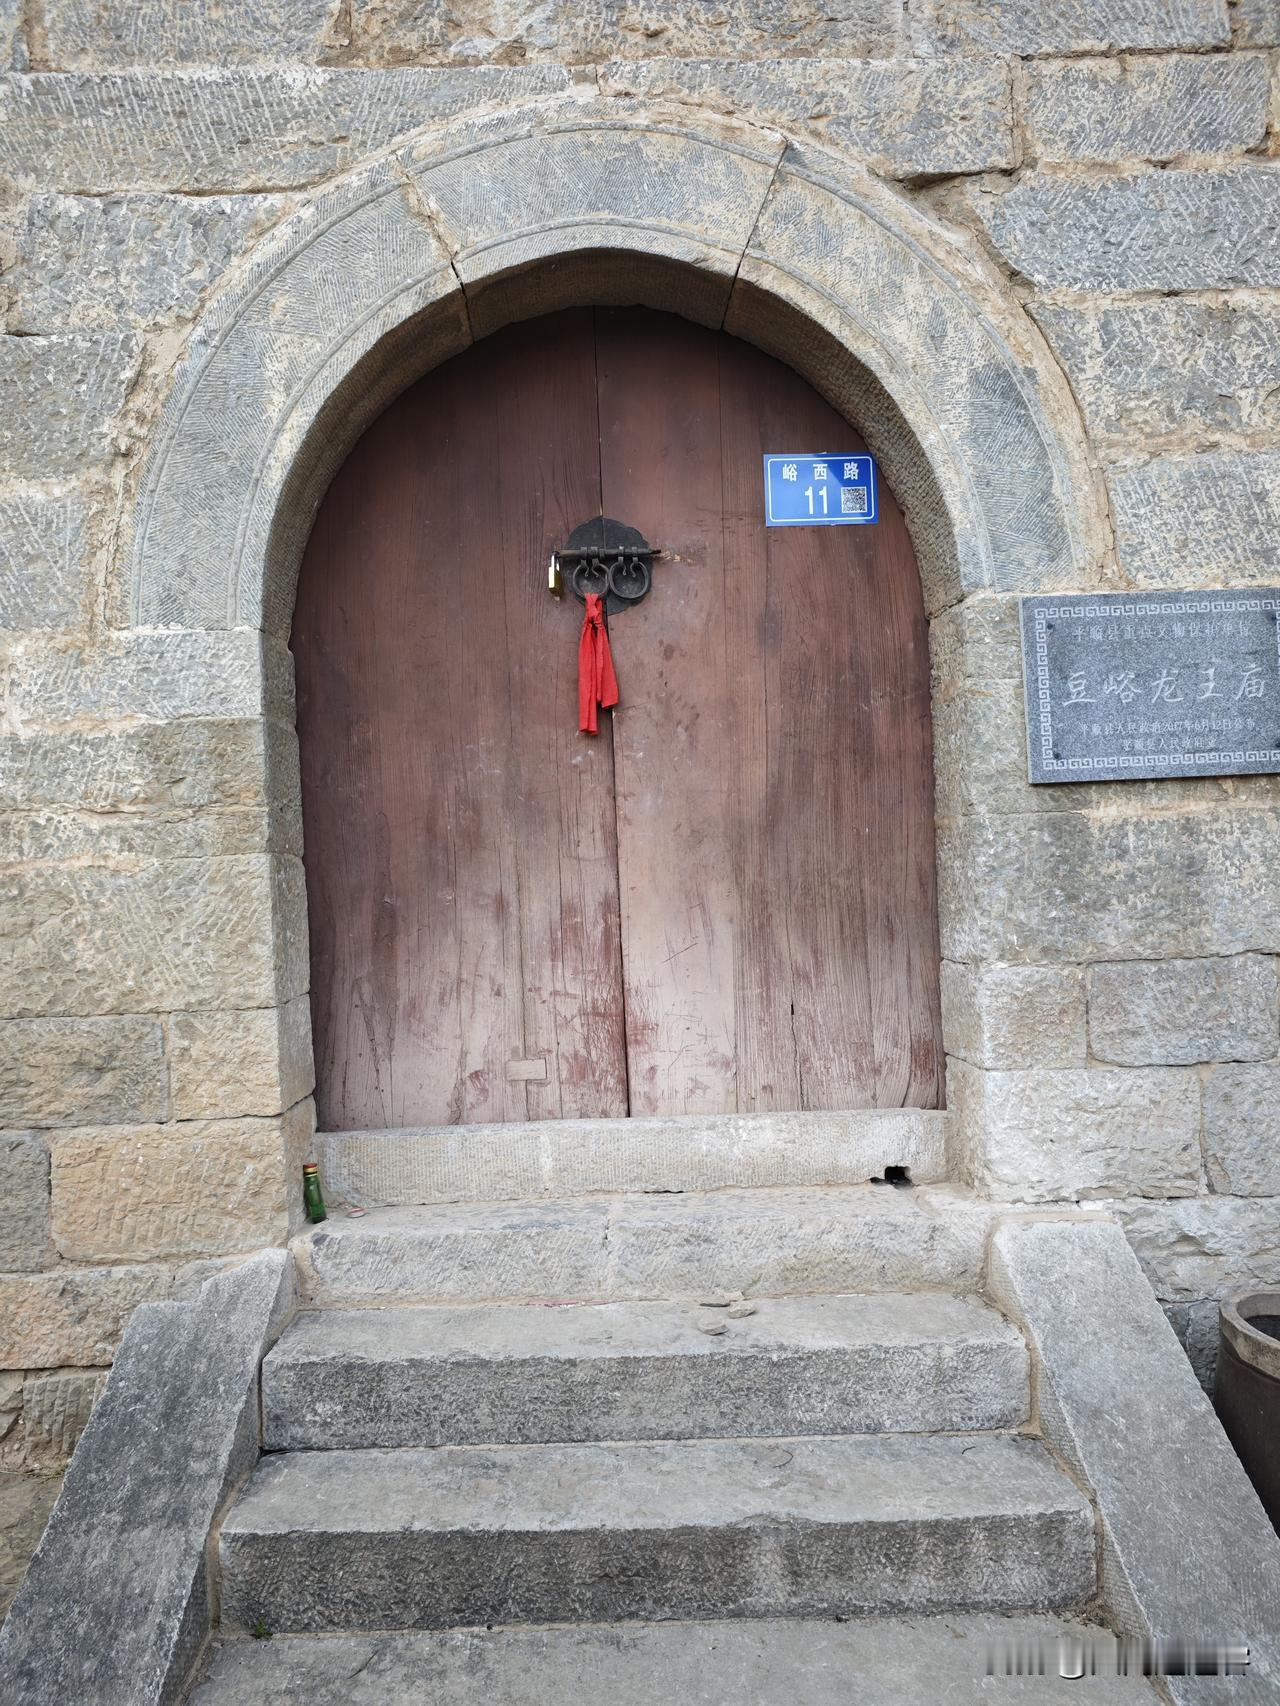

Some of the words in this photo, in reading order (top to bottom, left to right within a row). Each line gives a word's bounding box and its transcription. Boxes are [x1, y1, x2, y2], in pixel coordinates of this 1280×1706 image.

[782, 462, 859, 481] 峪西路
[804, 485, 828, 514] 11
[1062, 664, 1266, 707] 豆峪龙王庙
